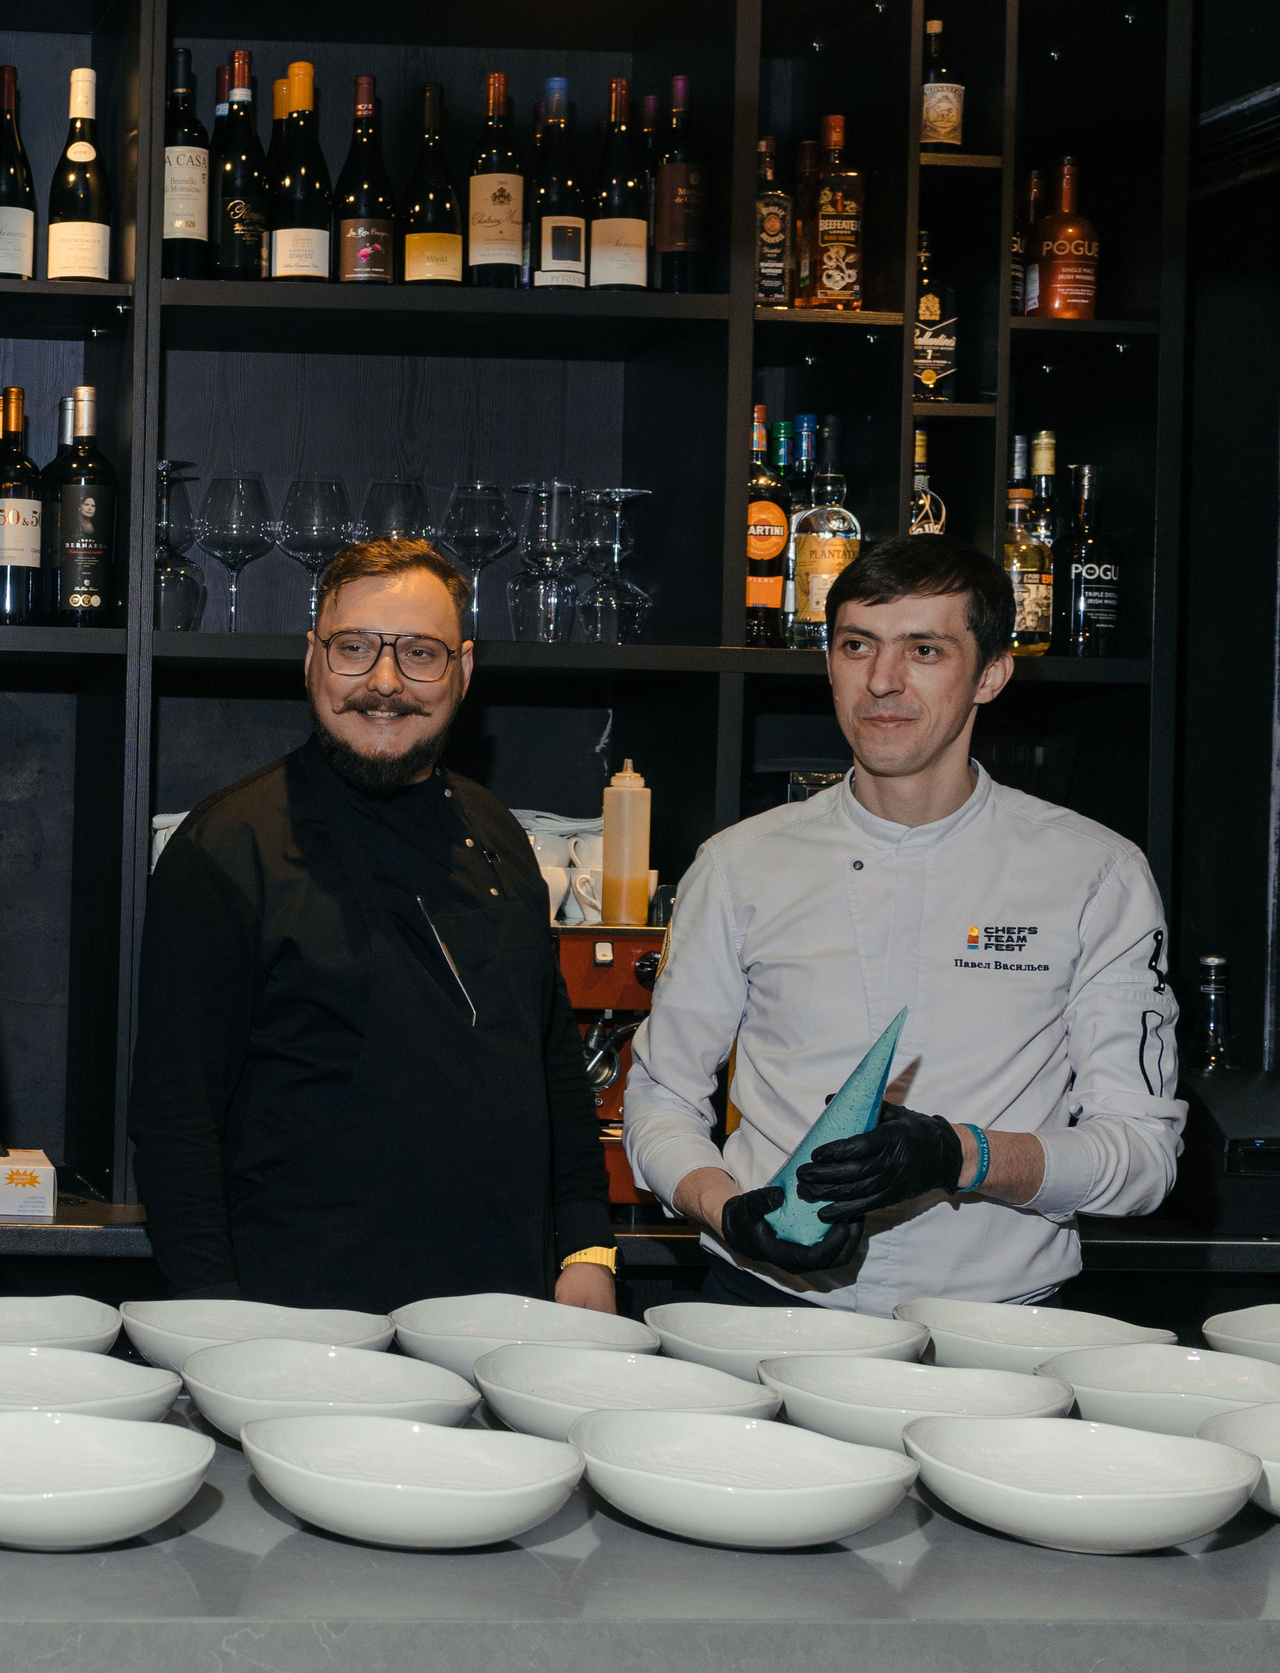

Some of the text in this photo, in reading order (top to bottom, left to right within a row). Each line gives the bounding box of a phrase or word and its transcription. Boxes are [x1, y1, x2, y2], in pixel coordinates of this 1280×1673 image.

[176, 153, 208, 169] CASA
[170, 177, 198, 185] Brunello
[819, 219, 861, 232] BEEFEATER
[926, 349, 933, 360] 7
[22, 517, 29, 526] &
[31, 510, 41, 528] 5
[983, 926, 1038, 935] CHEFS
[984, 934, 1028, 943] TEAM
[984, 943, 1026, 952] FEST
[953, 958, 1050, 972] Павел Васильев
